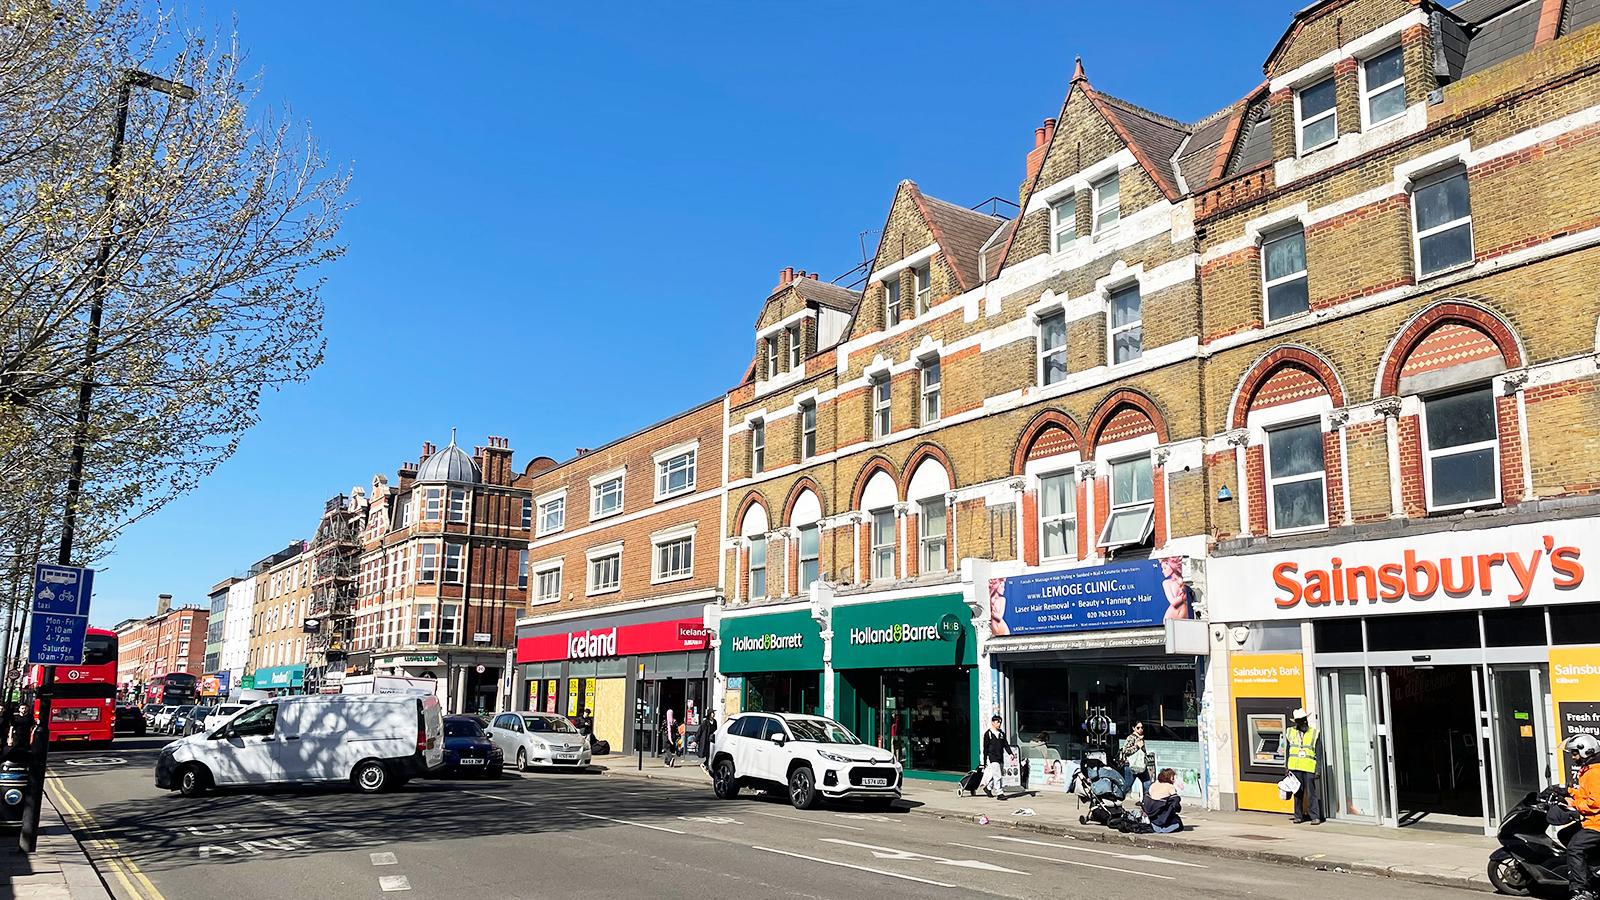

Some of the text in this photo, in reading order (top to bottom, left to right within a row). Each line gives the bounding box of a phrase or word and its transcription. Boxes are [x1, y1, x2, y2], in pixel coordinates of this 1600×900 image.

[1273, 535, 1584, 606] Sainsbury's
[1044, 601, 1070, 610] Removal
[1078, 600, 1100, 608] Beauty
[1106, 596, 1132, 606] Tanning
[1138, 594, 1152, 602] Hair
[680, 628, 706, 636] Iceland
[567, 626, 616, 658] Iceland
[42, 644, 71, 653] Saturday
[1233, 665, 1301, 679] Sainsbury's Bank
[1566, 713, 1588, 721] Fresh
[1568, 726, 1600, 735] Bakery
